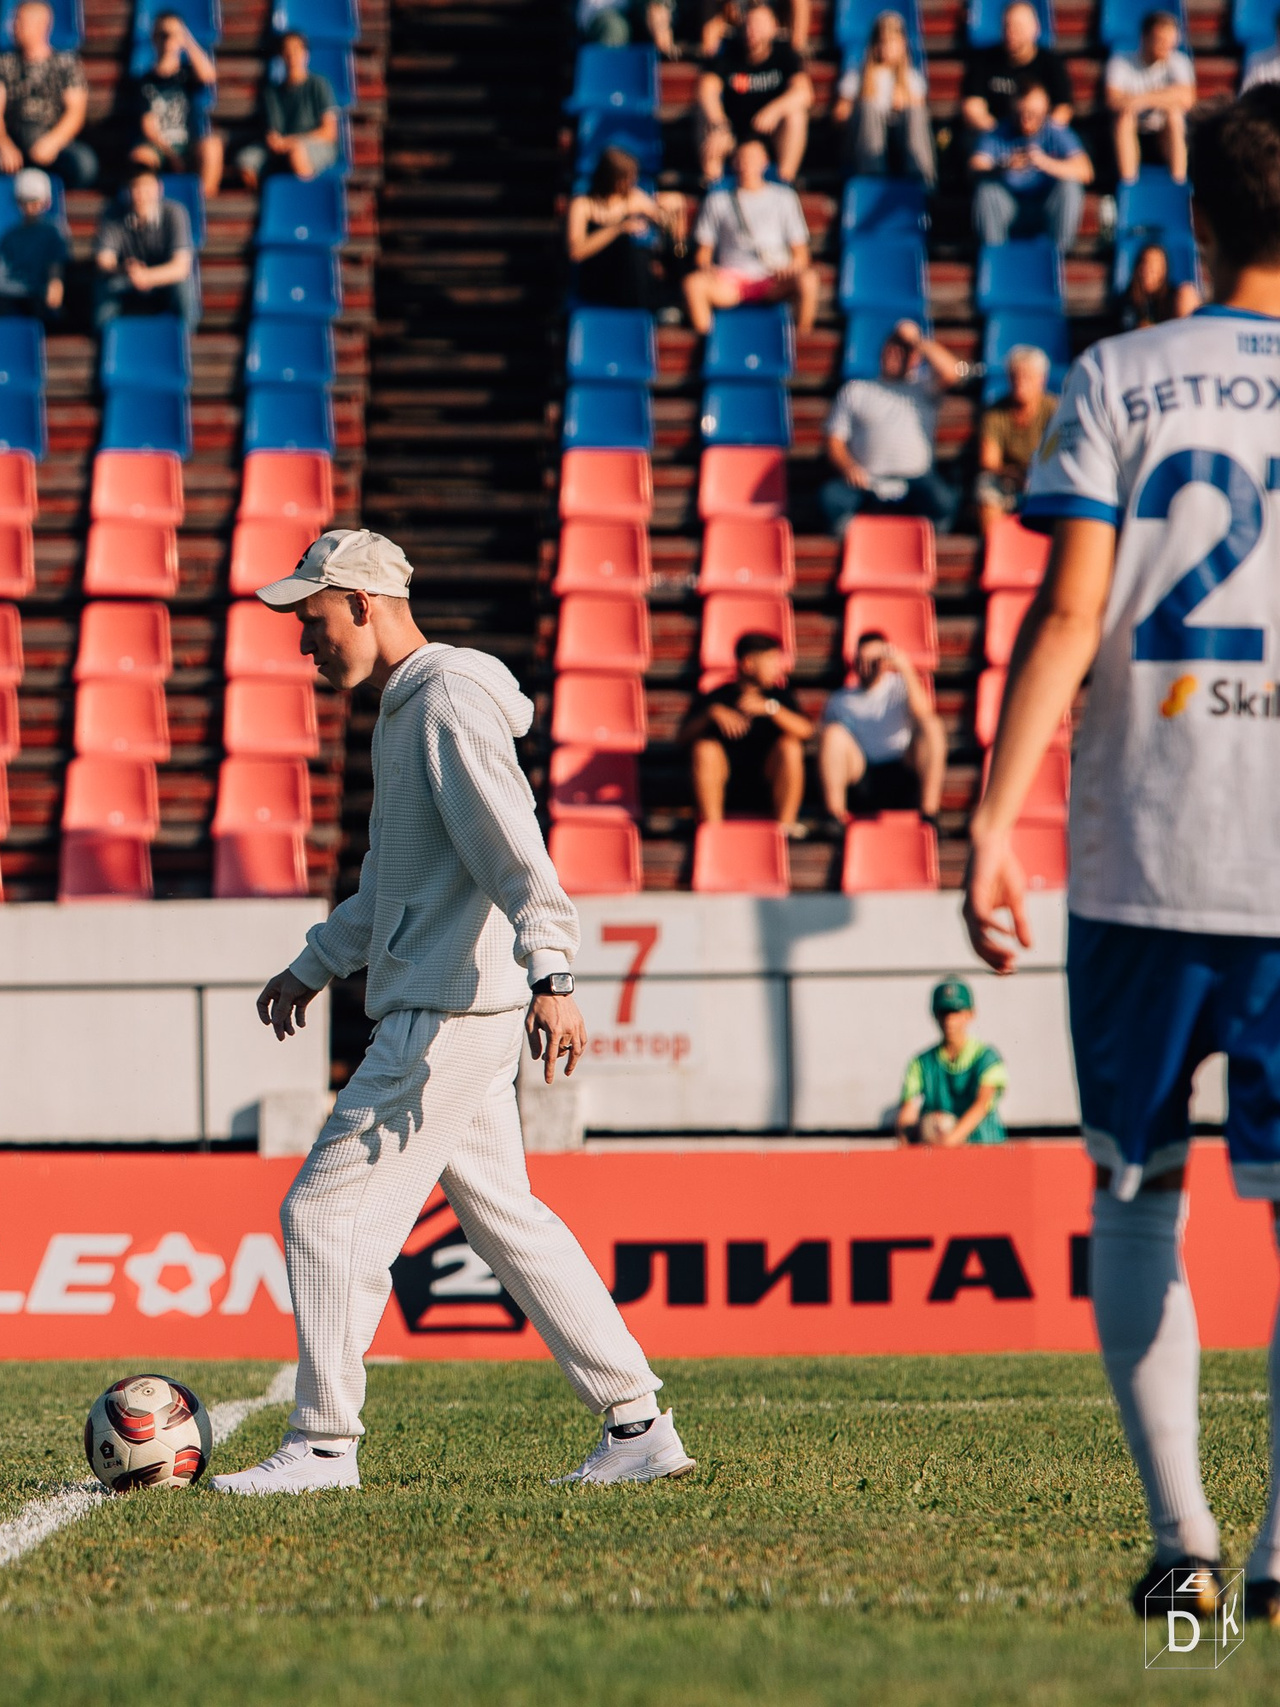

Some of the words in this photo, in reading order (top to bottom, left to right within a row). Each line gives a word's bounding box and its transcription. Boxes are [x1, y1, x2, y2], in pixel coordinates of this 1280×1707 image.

[1131, 449, 1280, 661] 2
[601, 925, 658, 1024] 7
[430, 1244, 503, 1297] 2
[610, 1235, 1034, 1308] ЛИГА
